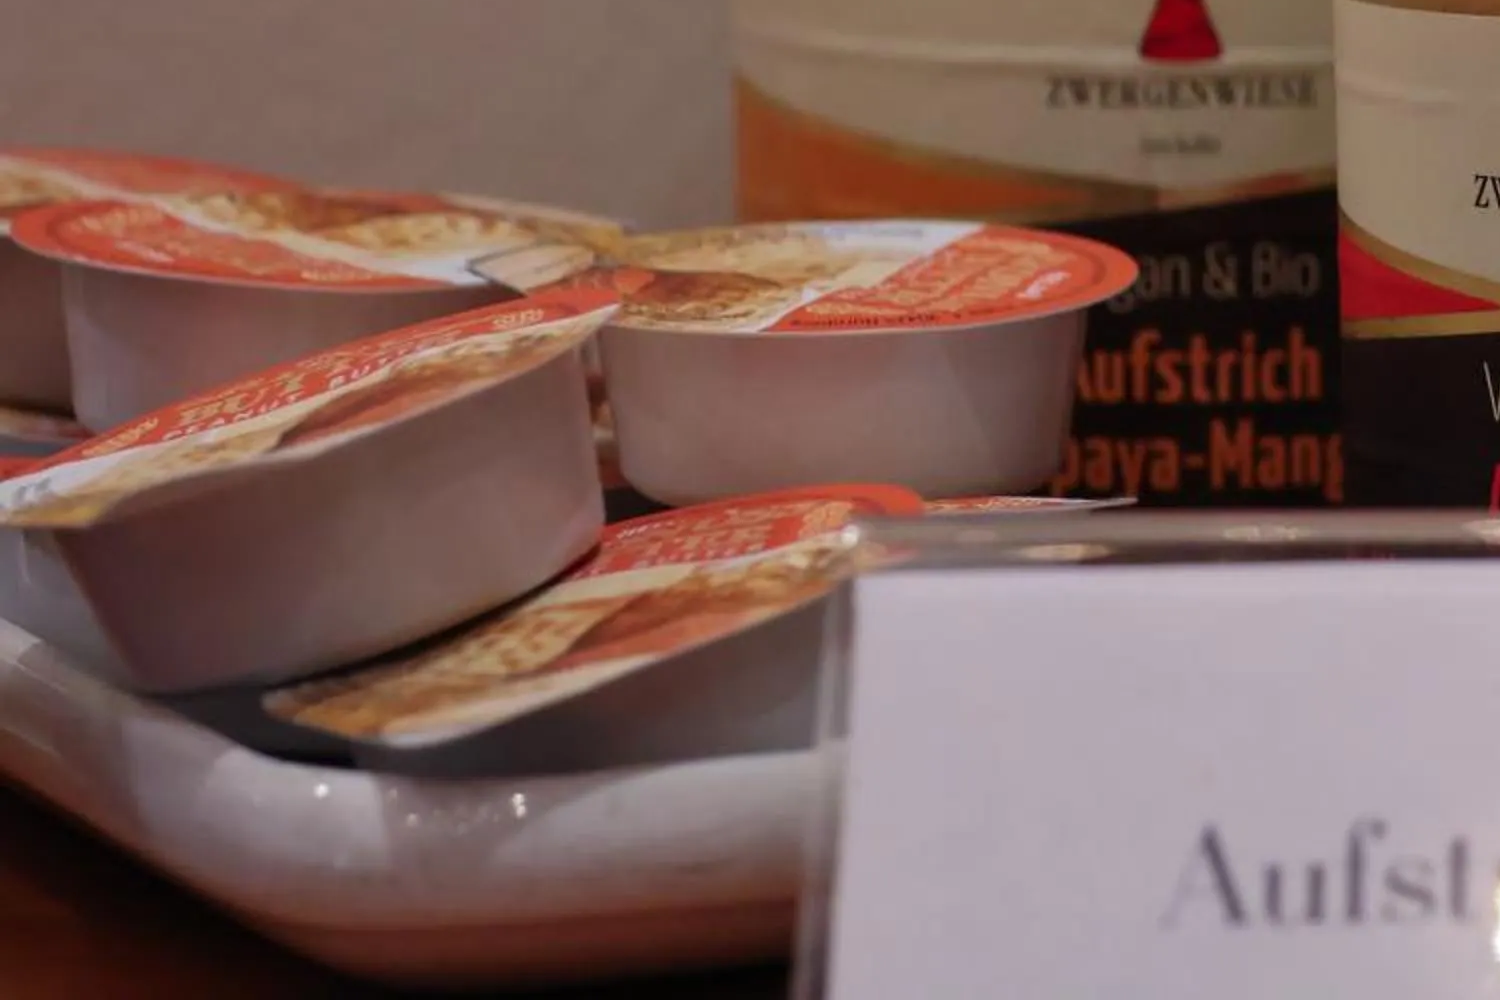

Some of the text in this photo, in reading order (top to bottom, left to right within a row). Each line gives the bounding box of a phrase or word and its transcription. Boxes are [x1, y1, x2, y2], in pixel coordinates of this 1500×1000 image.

[1046, 72, 1318, 111] ZWERGENWIESE
[1202, 241, 1239, 299] &
[1252, 240, 1321, 298] Bio
